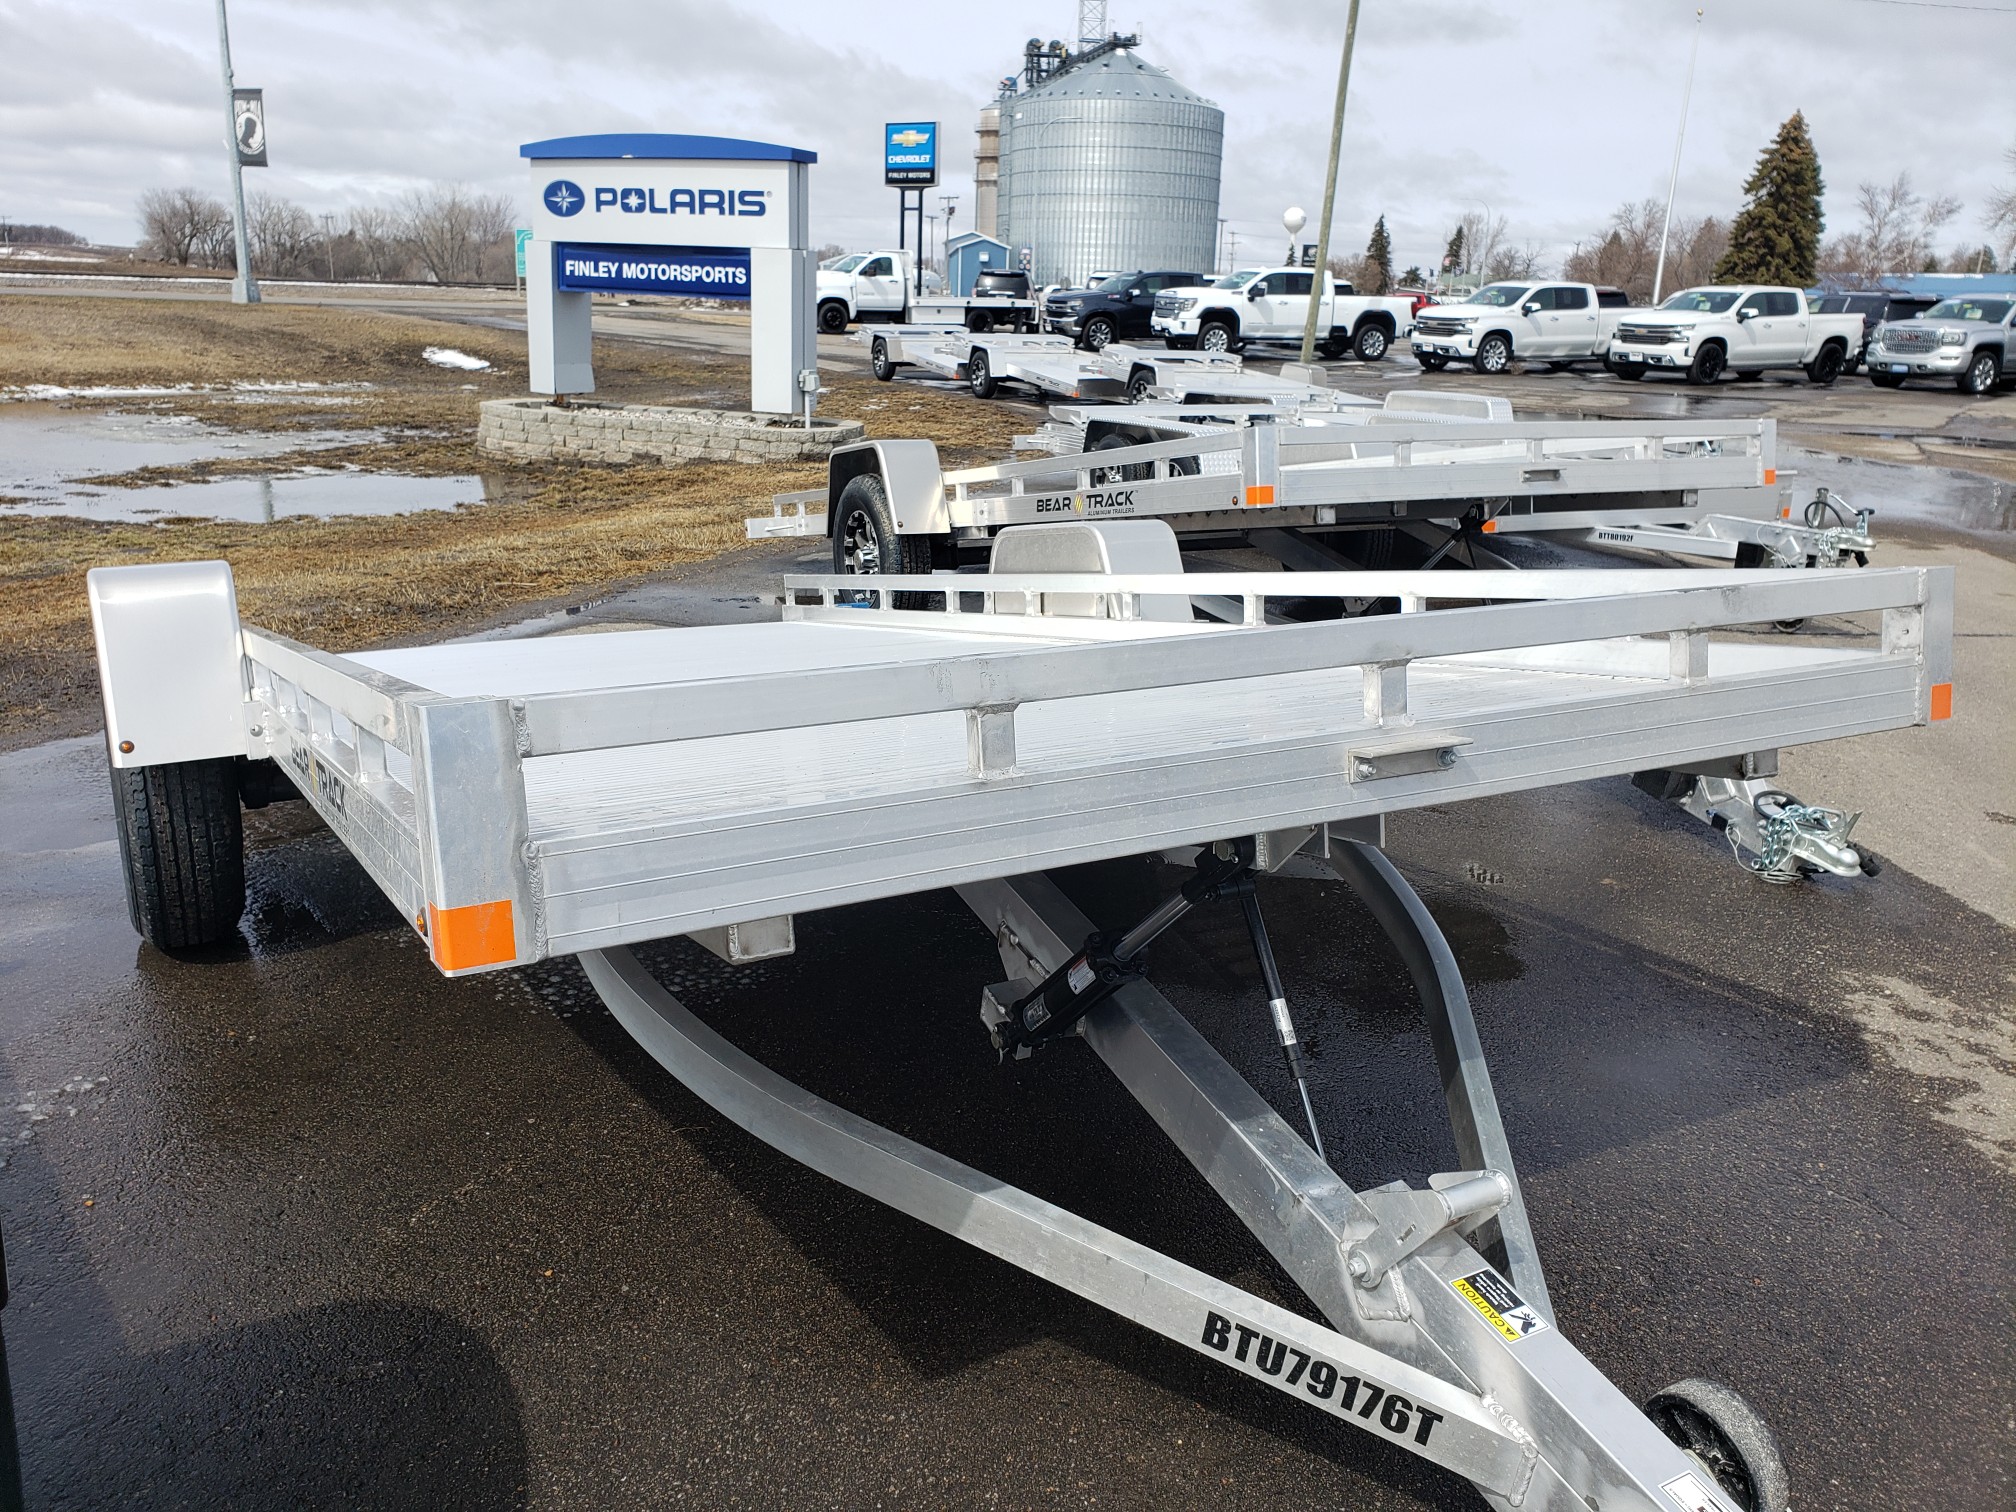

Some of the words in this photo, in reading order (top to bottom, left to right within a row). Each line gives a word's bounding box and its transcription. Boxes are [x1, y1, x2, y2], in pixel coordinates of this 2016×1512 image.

[888, 154, 931, 163] CHEVROLET
[594, 186, 767, 217] POLARIS
[565, 259, 619, 278] FINLEY
[622, 263, 747, 284] MOTORSPORTS
[1036, 497, 1071, 512] BEAR
[1086, 490, 1134, 508] TRACK
[315, 758, 348, 822] TRACK
[1458, 1283, 1506, 1328] CAUTION
[1201, 1310, 1443, 1446] BTU79176T
